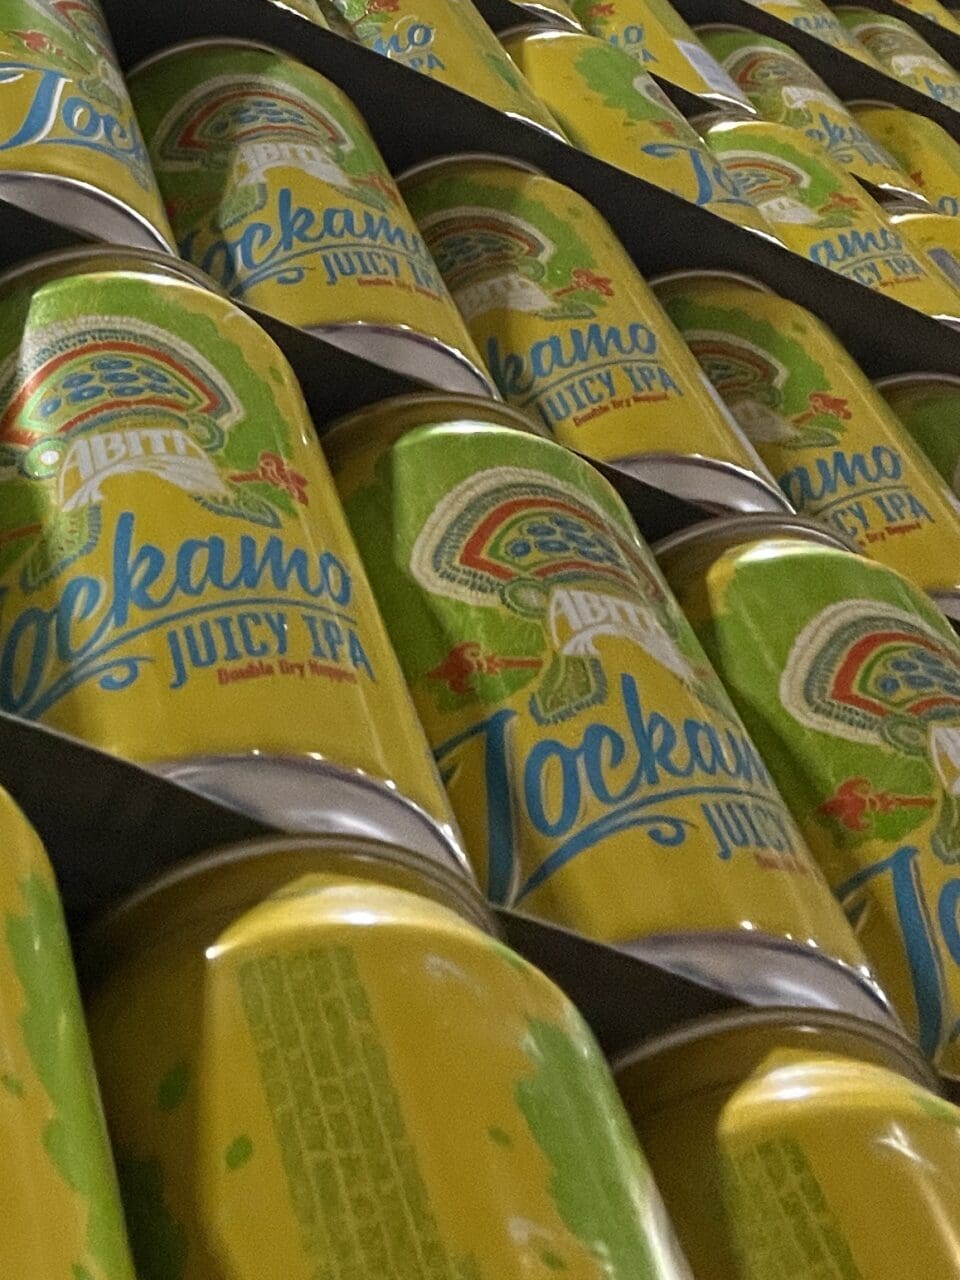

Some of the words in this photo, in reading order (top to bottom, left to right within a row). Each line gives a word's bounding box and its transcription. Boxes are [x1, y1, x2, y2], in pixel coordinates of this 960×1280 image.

[619, 364, 684, 398] IPA
[873, 490, 938, 524] IPA
[167, 611, 288, 689] JUICY
[300, 613, 377, 683] IPA
